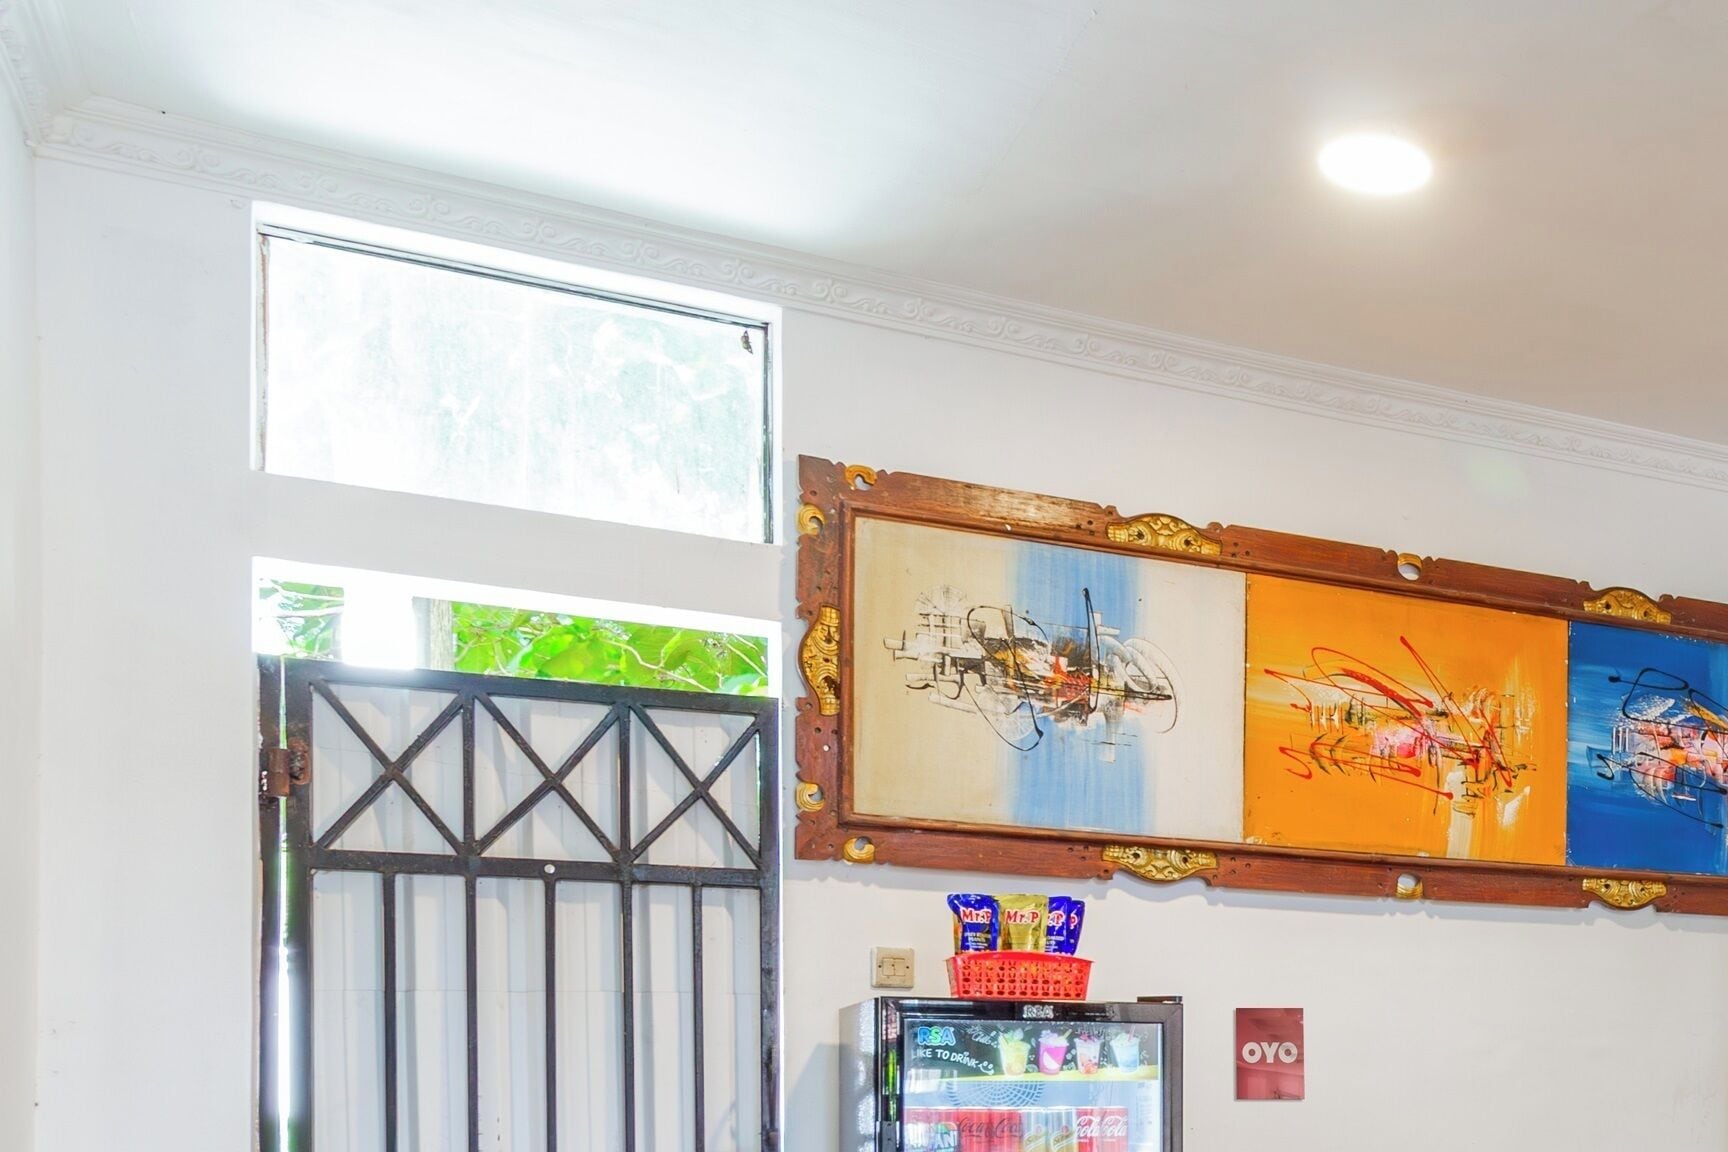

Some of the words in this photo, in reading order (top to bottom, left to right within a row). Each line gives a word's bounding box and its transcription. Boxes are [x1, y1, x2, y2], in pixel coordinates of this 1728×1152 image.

[917, 1026, 956, 1046] RSA
[936, 1049, 950, 1060] TO
[1242, 1041, 1298, 1064] OYO
